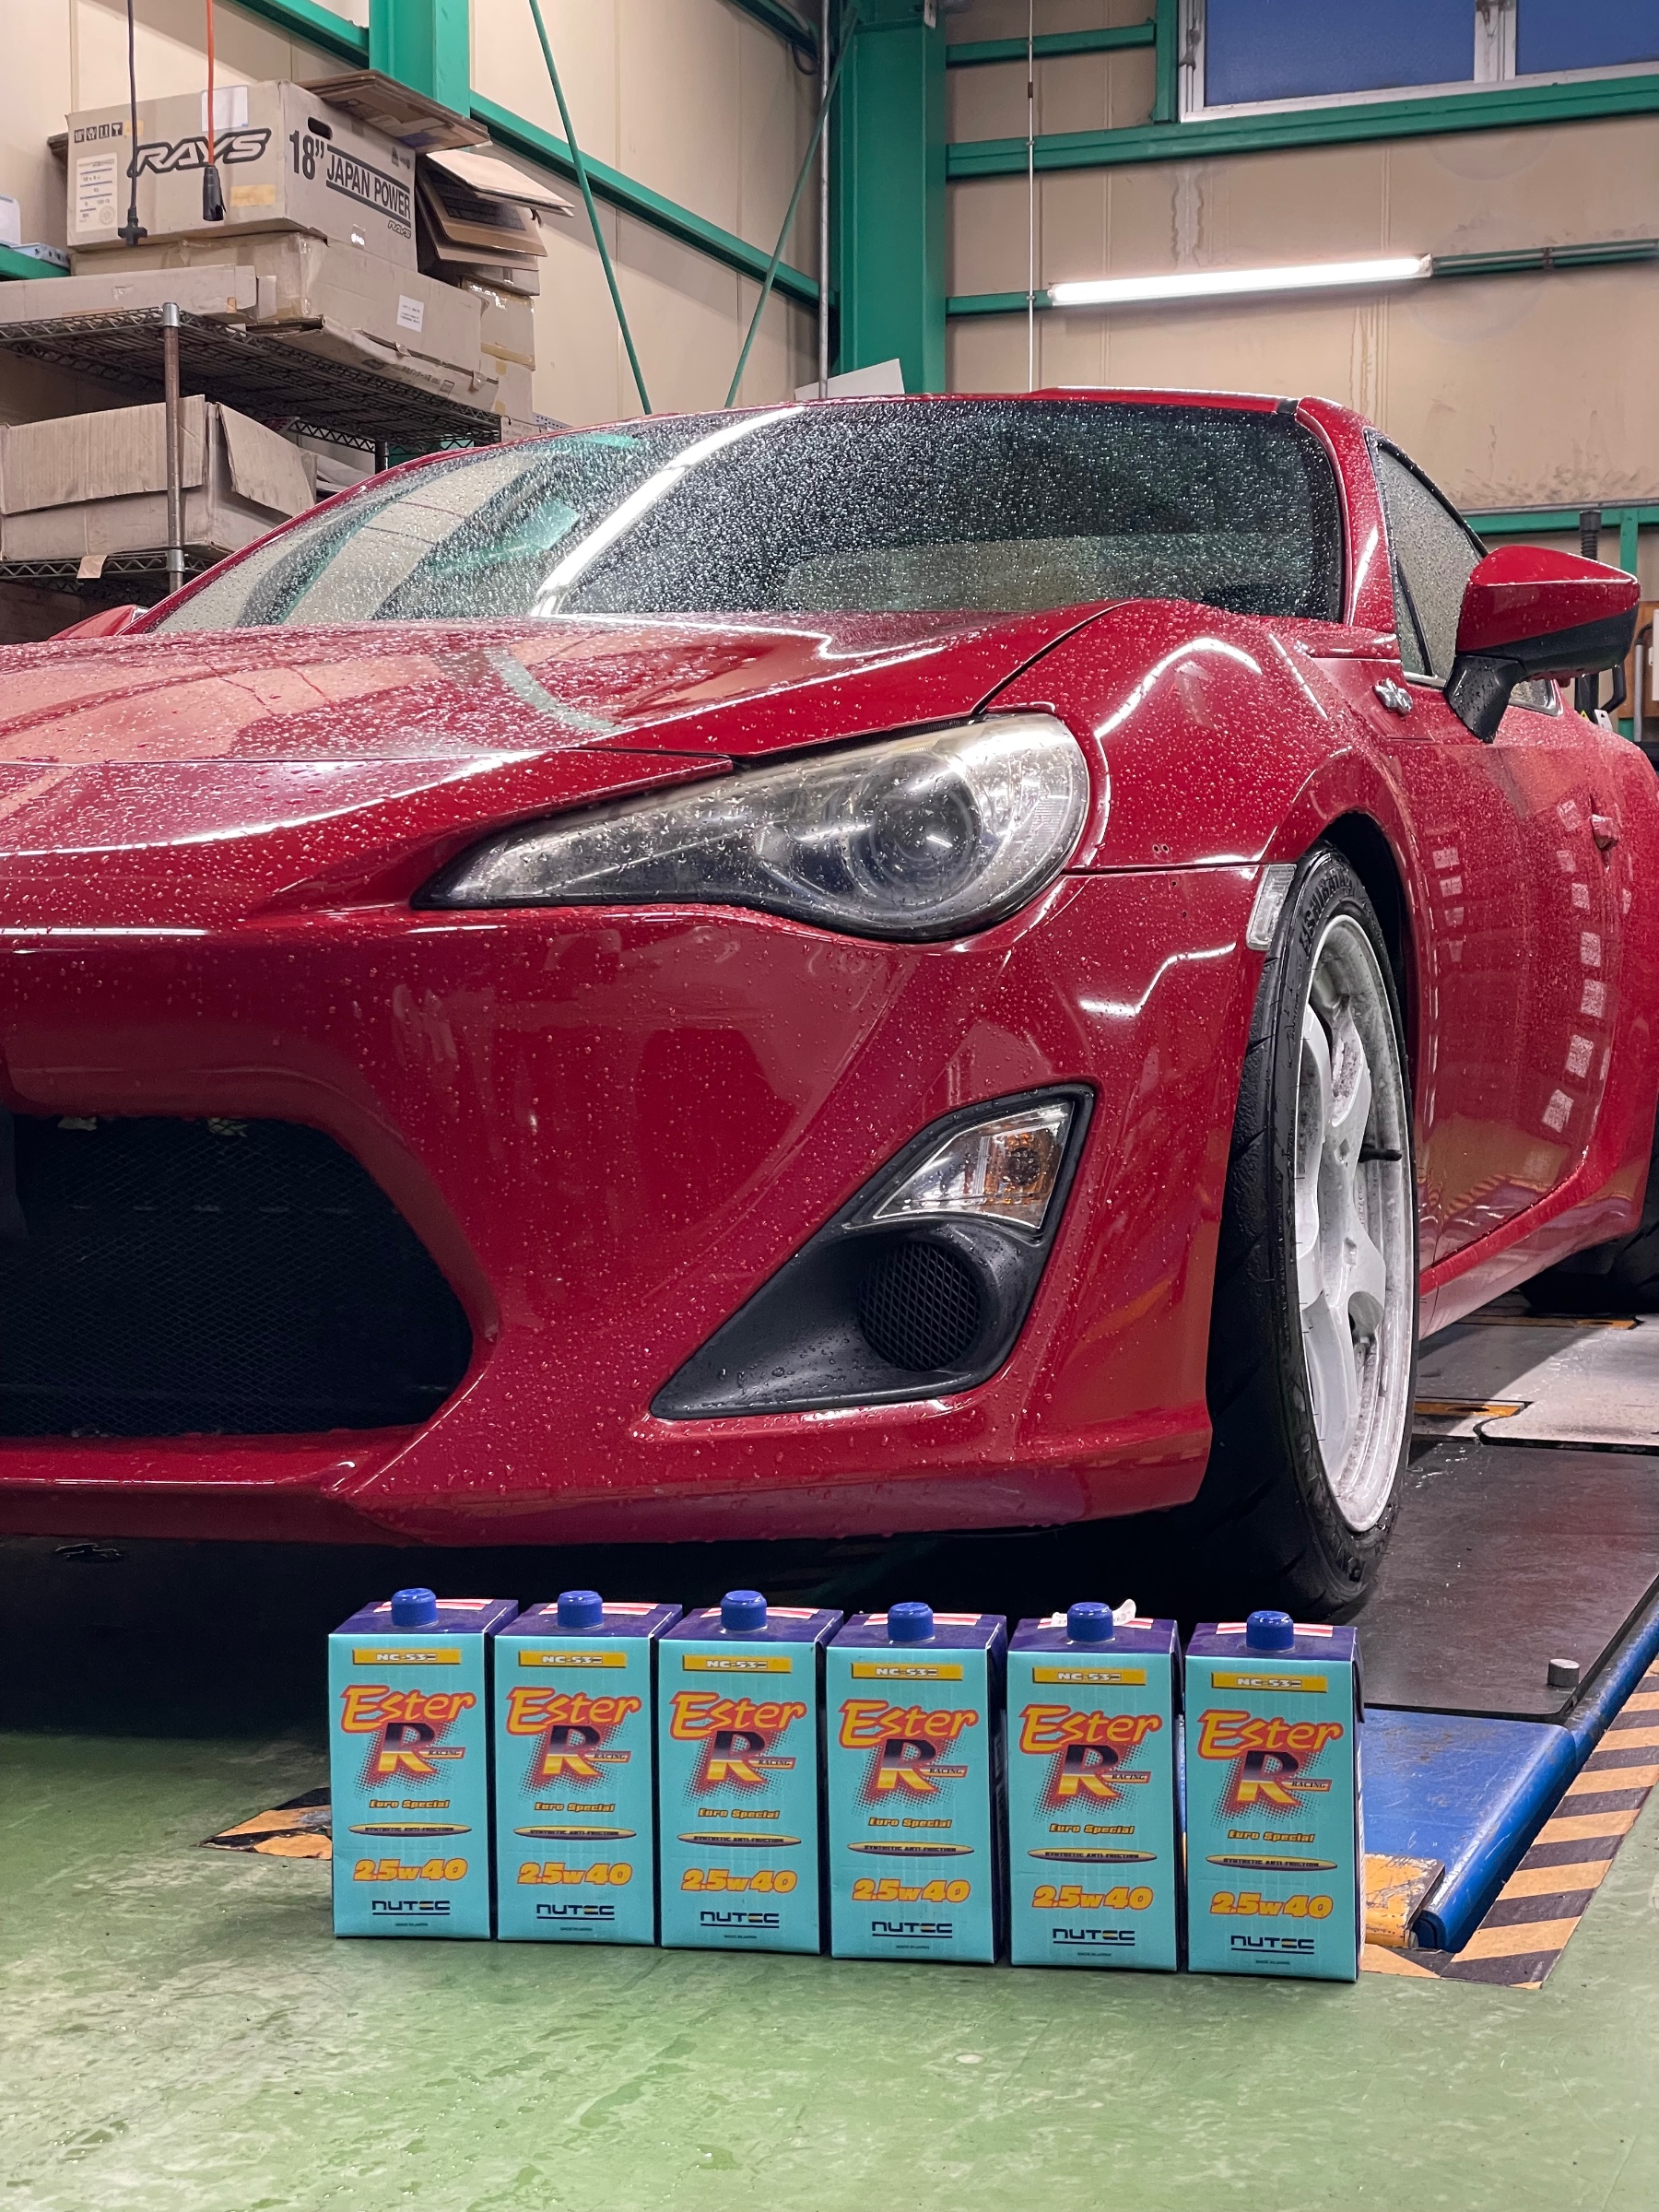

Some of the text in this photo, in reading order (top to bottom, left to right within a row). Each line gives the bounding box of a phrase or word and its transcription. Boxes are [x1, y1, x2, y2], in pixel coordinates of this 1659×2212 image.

[127, 128, 271, 177] RAYS
[327, 155, 411, 219] JAPAN POWER
[387, 219, 411, 239] RAYS
[340, 1685, 477, 1734] Ester
[505, 1687, 642, 1735] Ester
[669, 1691, 807, 1740] Ester
[838, 1700, 979, 1748] Ester
[1019, 1704, 1162, 1754] Ester
[379, 1723, 433, 1771] R
[543, 1725, 599, 1775] R
[707, 1731, 763, 1782] R
[1197, 1709, 1344, 1759] Ester
[877, 1739, 935, 1790] R
[1058, 1745, 1118, 1795] R
[1237, 1750, 1298, 1803] R
[370, 1800, 450, 1809] Euro Special
[535, 1802, 615, 1812] Euro Special
[698, 1808, 780, 1818] Euro Special
[868, 1818, 952, 1828] Euro Special
[1050, 1824, 1135, 1834] Euro Special
[1228, 1830, 1315, 1842] Euro Special
[372, 1900, 450, 1910] NUTEC
[536, 1904, 614, 1914] NUTEC
[700, 1912, 779, 1923] NUTEC
[872, 1922, 952, 1933] NUTEC
[1053, 1929, 1135, 1940] NUTEC
[1231, 1936, 1314, 1948] NUTEC
